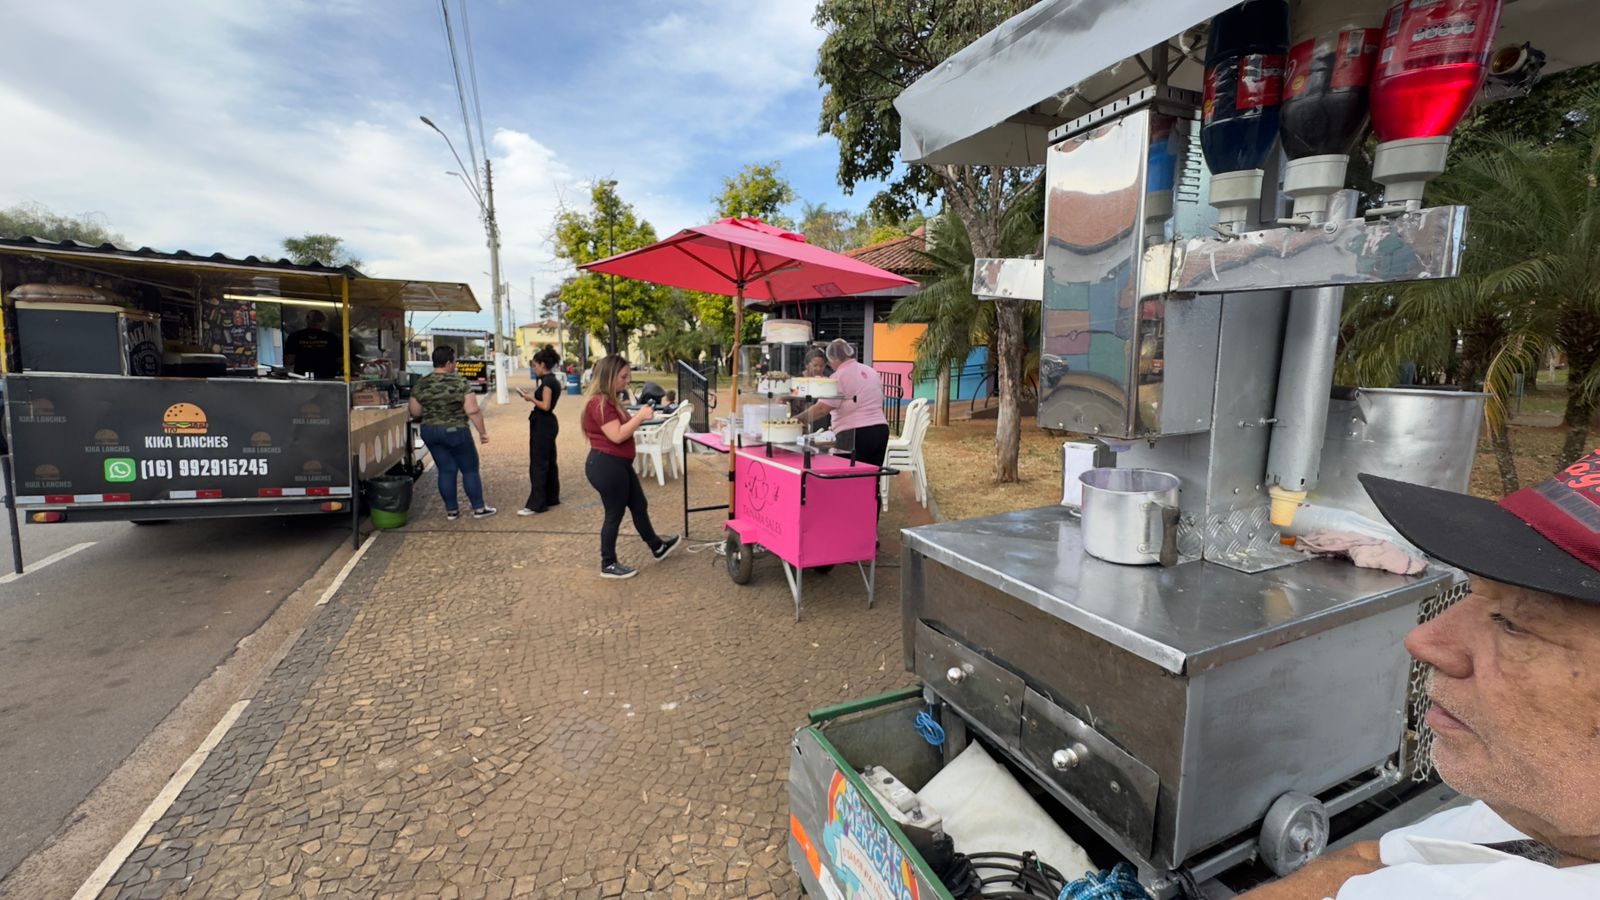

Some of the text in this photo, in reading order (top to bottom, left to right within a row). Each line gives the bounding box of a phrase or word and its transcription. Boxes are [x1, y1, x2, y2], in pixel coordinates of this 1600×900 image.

[145, 436, 229, 448] KIKA LANCHES
[141, 458, 269, 480] (16) 992915245
